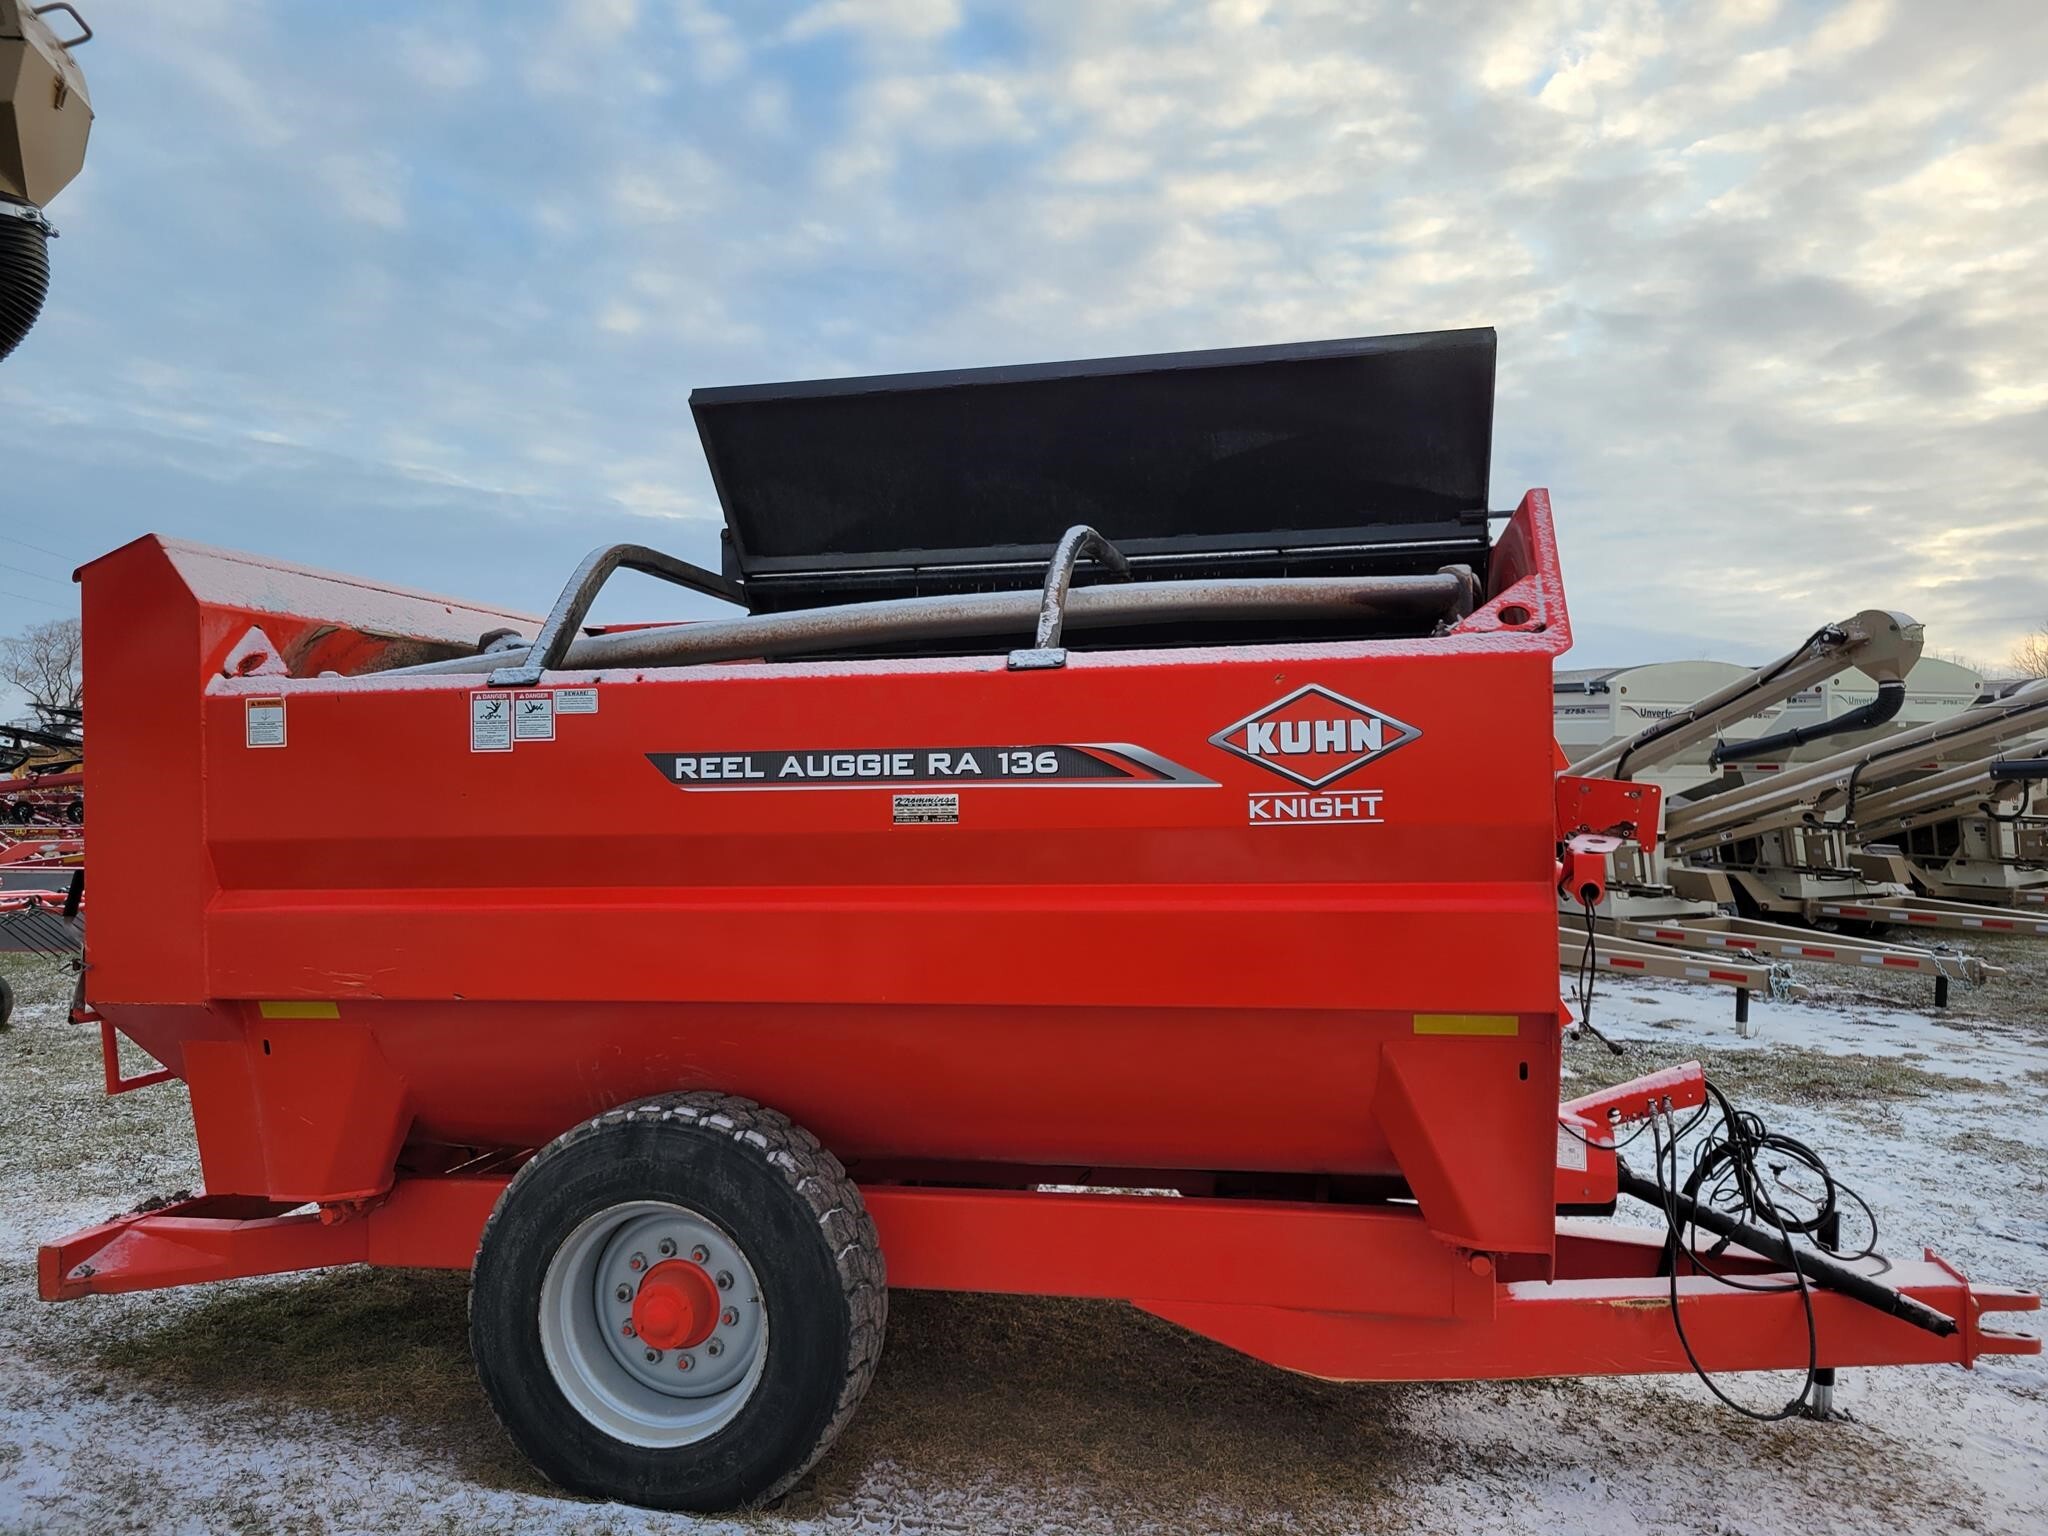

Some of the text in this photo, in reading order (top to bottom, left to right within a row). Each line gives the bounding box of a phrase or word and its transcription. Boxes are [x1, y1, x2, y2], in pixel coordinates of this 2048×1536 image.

[1246, 718, 1383, 755] KUHN
[675, 751, 1059, 779] REEL AUGGIE RA 136
[1248, 796, 1384, 819] KNIGHT
